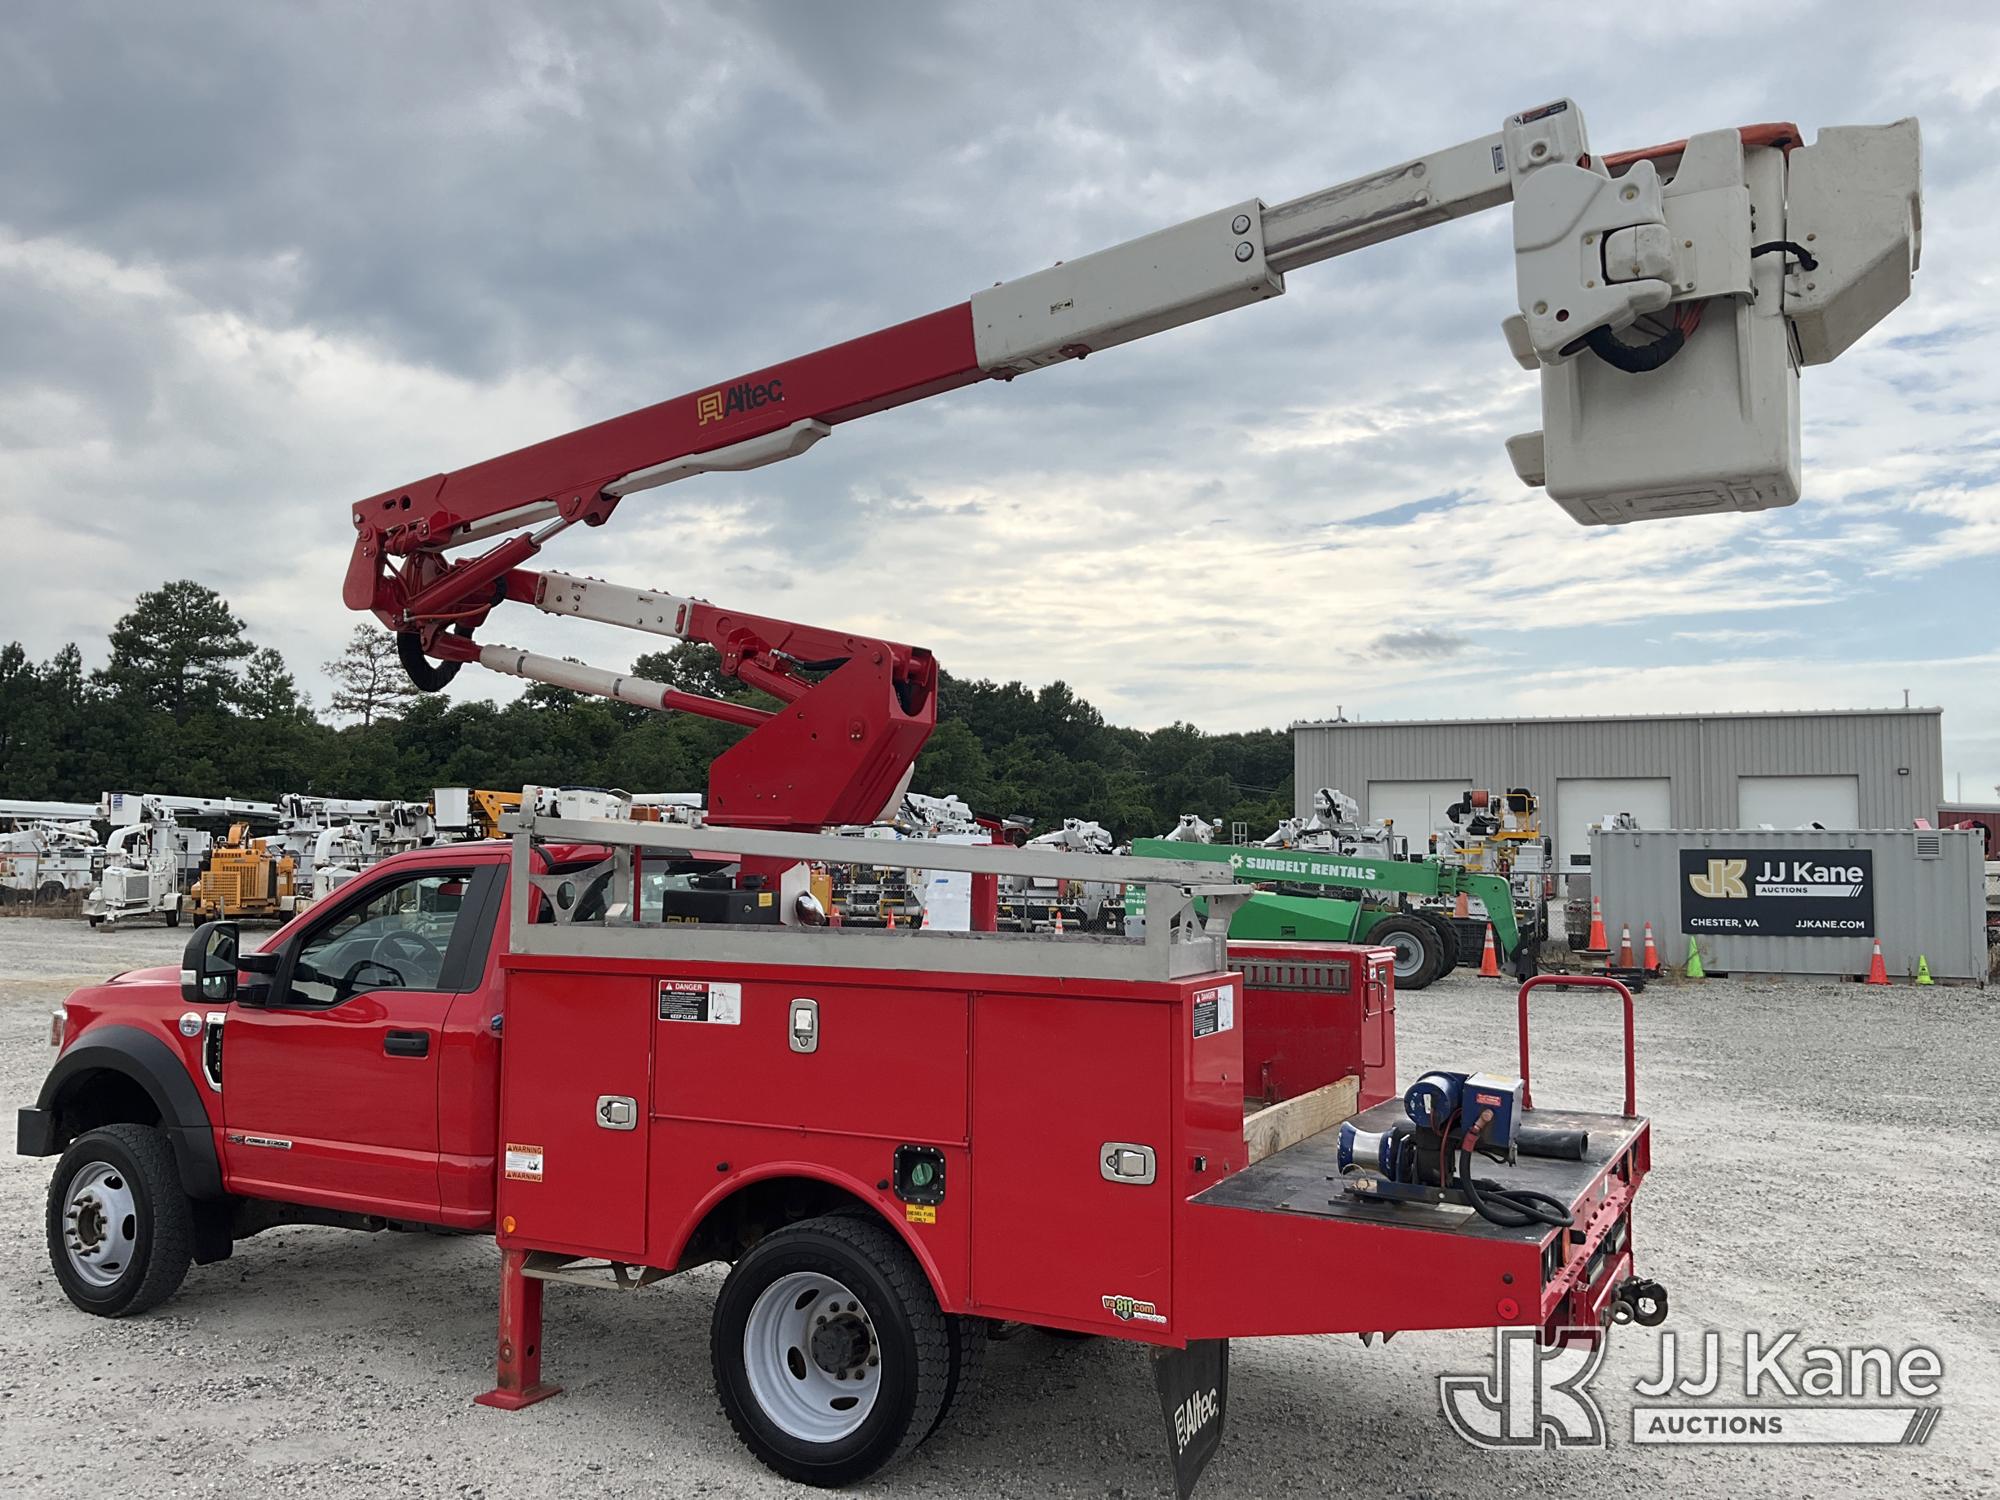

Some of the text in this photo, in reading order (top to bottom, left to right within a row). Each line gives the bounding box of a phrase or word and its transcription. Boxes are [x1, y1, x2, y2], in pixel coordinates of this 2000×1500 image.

[724, 379, 783, 417] Altec
[1246, 857, 1376, 880] SUNBELT RENTALS
[1755, 862, 1864, 883] JJ Kane
[1761, 886, 1809, 895] AUCTIONS
[1690, 918, 1760, 928] CHESTER, VA
[1795, 919, 1865, 929] JJKANE.COM
[675, 983, 703, 991] DANGER
[512, 1144, 542, 1154] WARNING
[511, 1171, 541, 1180] WARNING
[1104, 1299, 1154, 1314] va811.com
[1186, 1387, 1217, 1442] Altec
